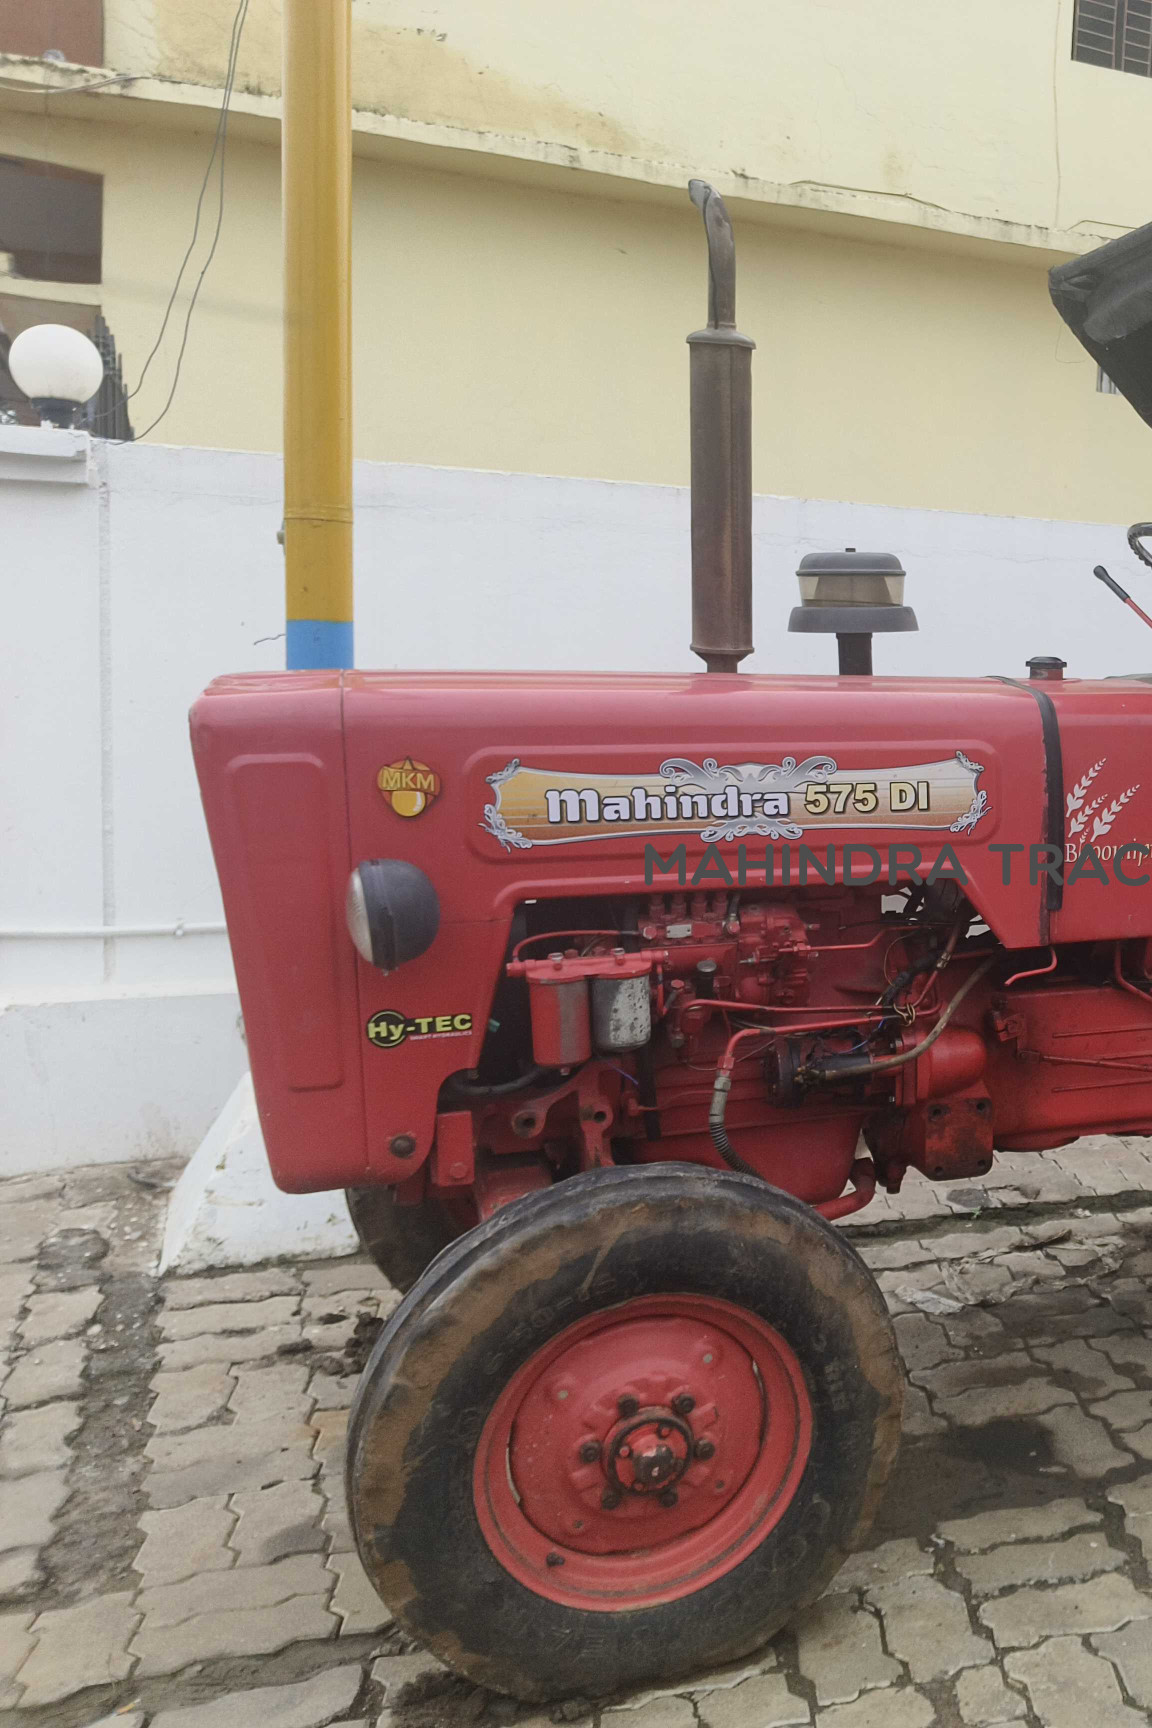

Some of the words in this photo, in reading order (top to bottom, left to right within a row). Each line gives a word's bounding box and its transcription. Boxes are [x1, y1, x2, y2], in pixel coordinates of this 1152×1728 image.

[382, 767, 435, 792] MKM
[804, 783, 879, 815] 575
[889, 781, 930, 811] DI
[367, 1014, 472, 1041] Hy-TEC
